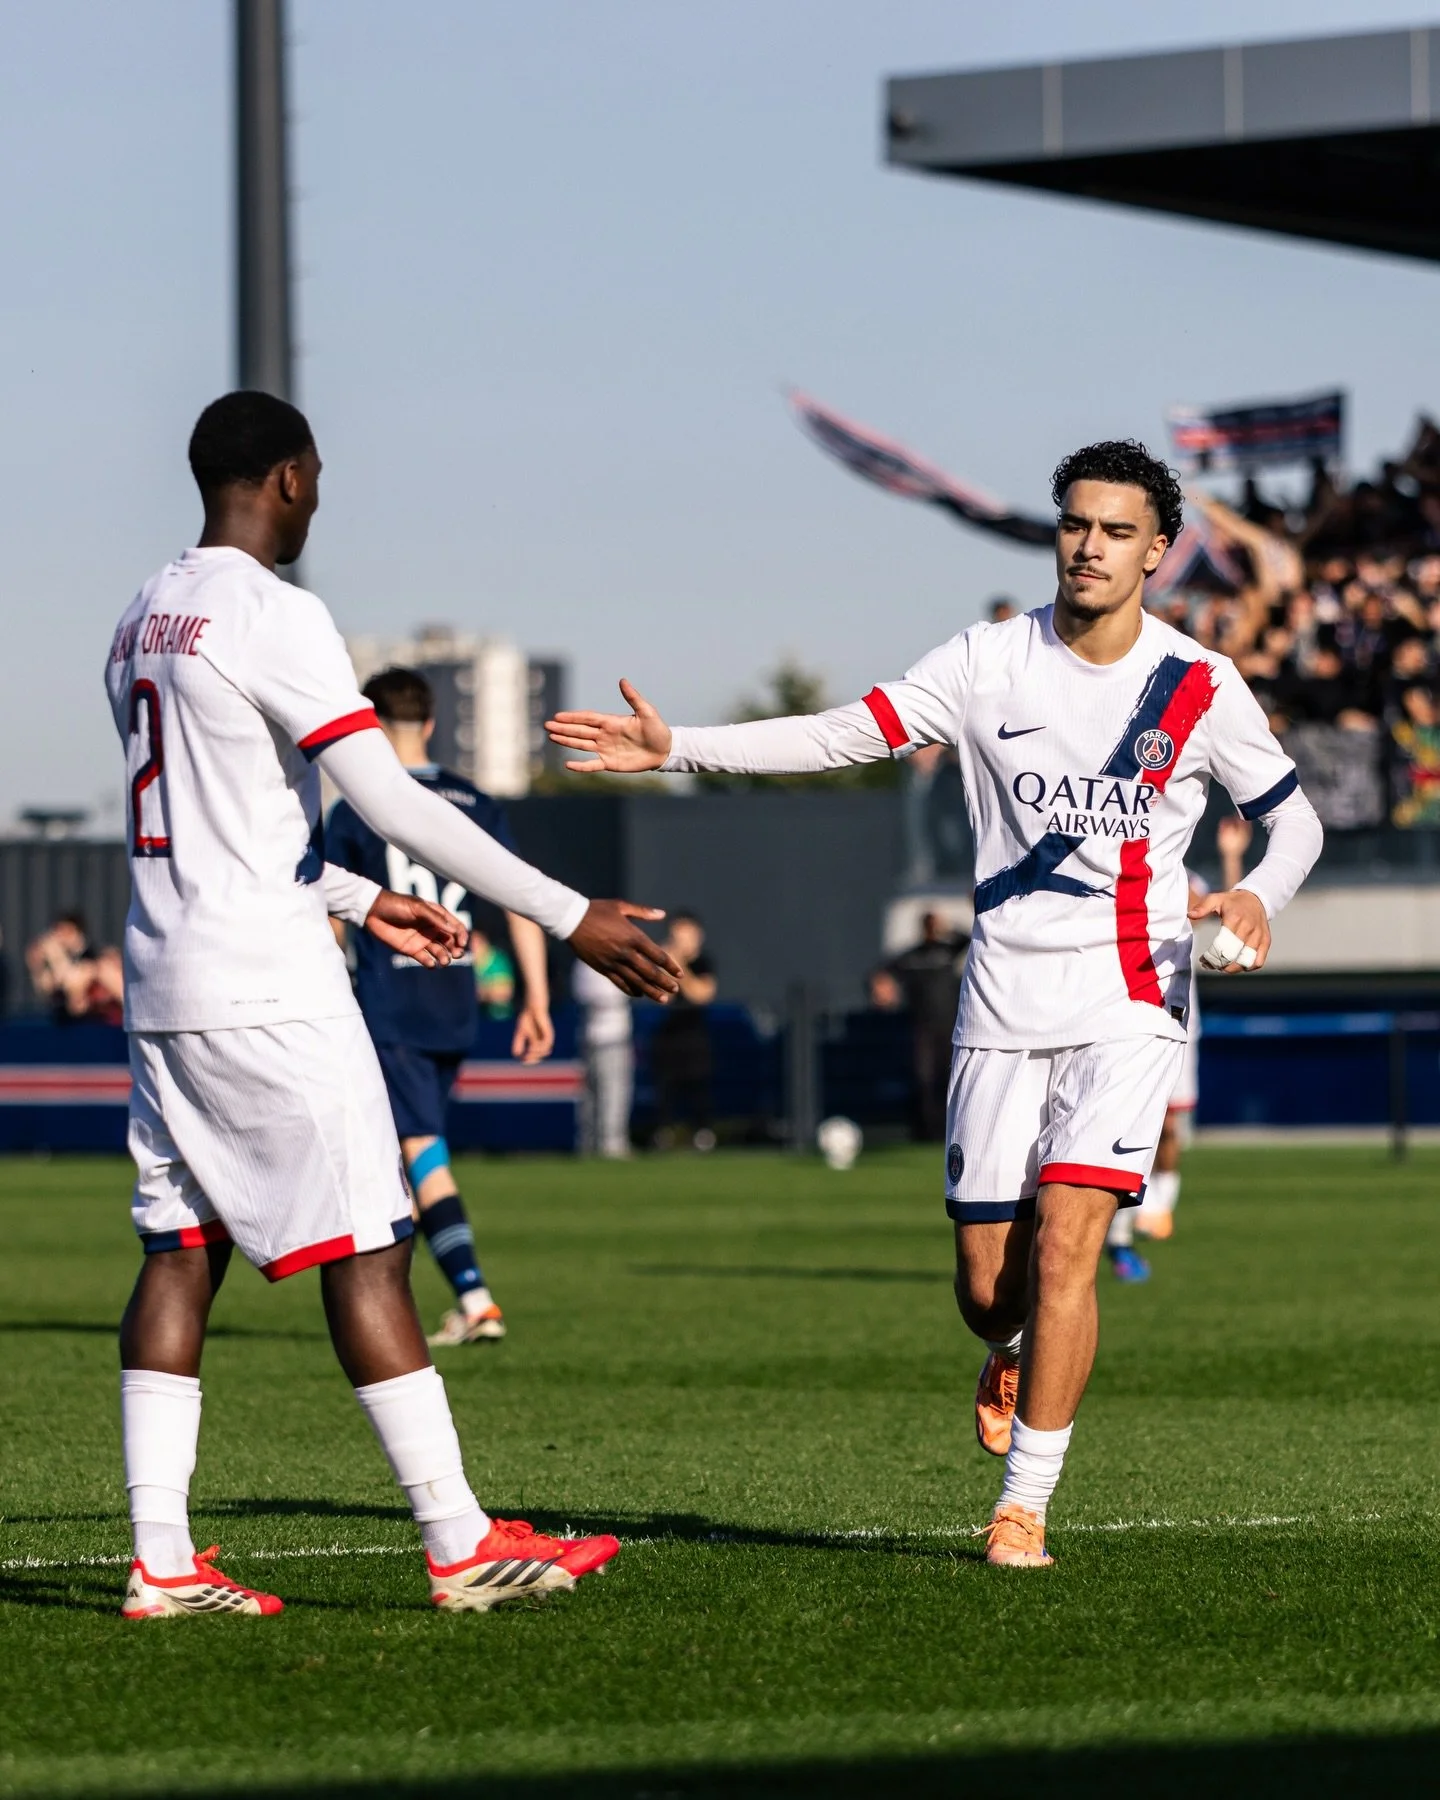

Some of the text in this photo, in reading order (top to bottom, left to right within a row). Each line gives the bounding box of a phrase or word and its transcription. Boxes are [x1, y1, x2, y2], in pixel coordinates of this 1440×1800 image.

[142, 614, 210, 656] DRAME
[1143, 731, 1169, 744] PARIS
[129, 678, 171, 857] 2
[1013, 772, 1154, 815] QATAR
[1047, 812, 1149, 838] AIRWAYS
